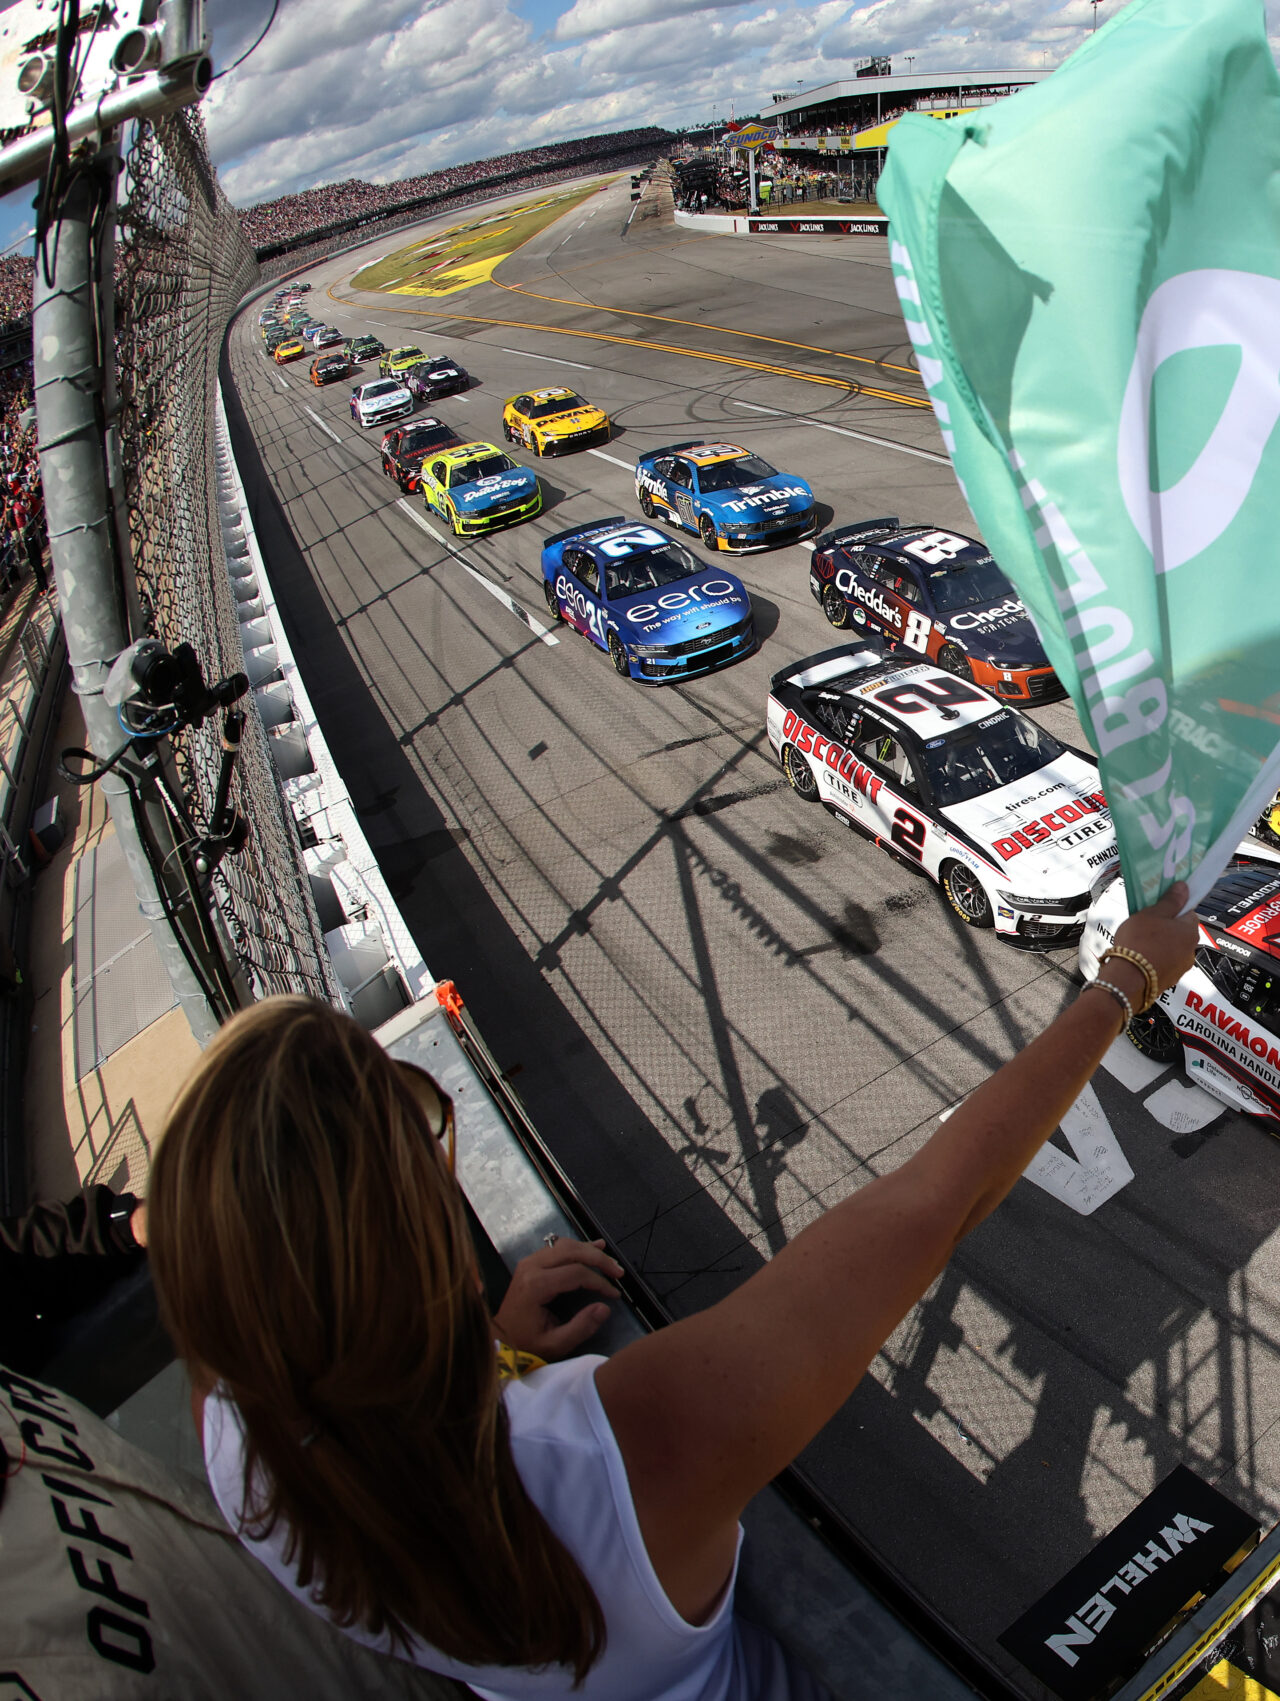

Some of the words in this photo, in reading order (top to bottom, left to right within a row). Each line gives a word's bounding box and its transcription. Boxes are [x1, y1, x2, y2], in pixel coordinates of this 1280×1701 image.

[729, 128, 777, 146] SUNOCO
[850, 223, 863, 233] JACK
[641, 468, 668, 502] Trimble
[721, 486, 807, 513] Trimble
[902, 531, 971, 565] 8
[555, 575, 588, 619] eero
[626, 580, 735, 623] eero
[642, 617, 661, 633] The
[661, 612, 683, 627] way
[682, 605, 700, 620] wifi
[700, 598, 731, 614] should
[730, 595, 742, 605] be
[835, 569, 903, 629] Cheddar's
[585, 600, 606, 642] 21
[902, 609, 932, 655] 8
[1001, 671, 1013, 682] 8
[873, 676, 990, 716] 2
[977, 711, 1011, 730] CINDRIC
[782, 708, 887, 807] DISCOUNT
[825, 773, 861, 805] TIRE
[1004, 781, 1067, 813] tires.com
[890, 806, 928, 863] 2
[1060, 818, 1107, 848] TIRE
[1176, 1013, 1237, 1060] CAROLINA
[1206, 1062, 1232, 1082] Delaware
[1043, 1512, 1216, 1668] WHELEN
